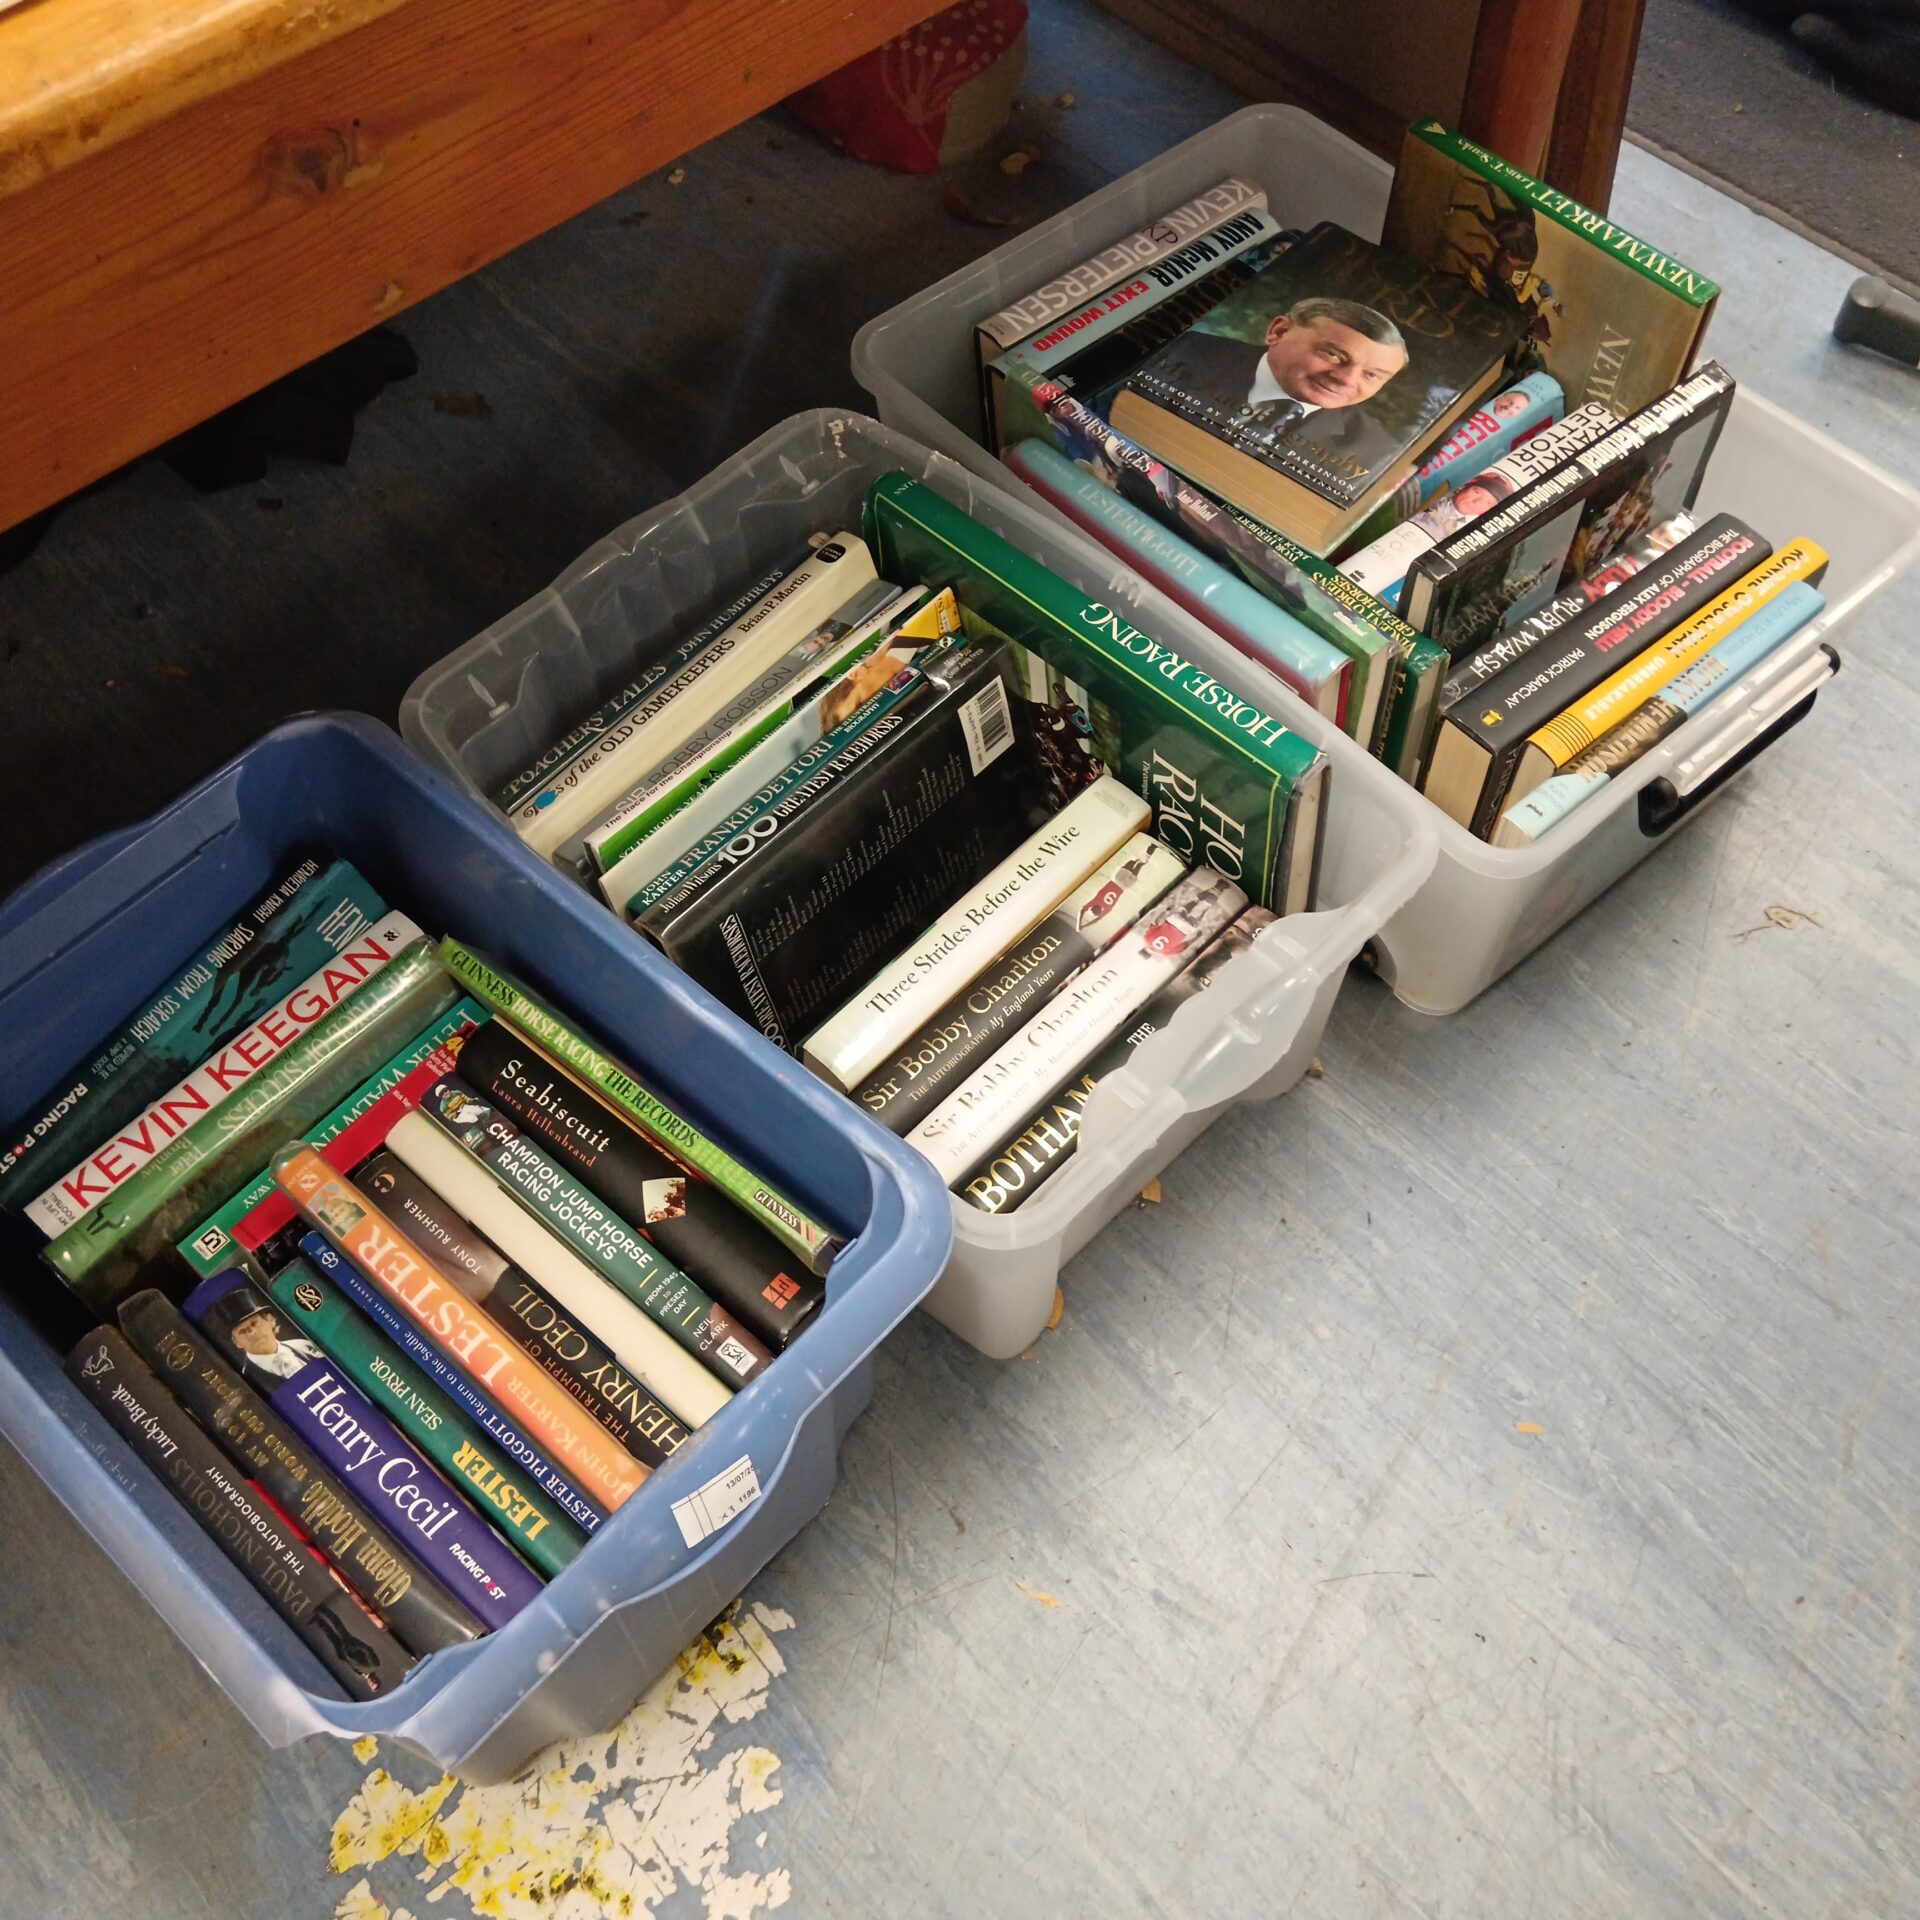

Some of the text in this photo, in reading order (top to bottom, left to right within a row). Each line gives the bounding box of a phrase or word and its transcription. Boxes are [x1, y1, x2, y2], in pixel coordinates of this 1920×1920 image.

[1165, 178, 1255, 237] KEVIN
[1222, 213, 1264, 251] ANDY
[1532, 188, 1706, 296] NEWMARKET
[998, 231, 1168, 332] PIETERSEN
[1102, 280, 1150, 312] EXIT
[1149, 239, 1220, 287] McNAB
[1032, 304, 1105, 352] WOUND
[1021, 371, 1070, 409] CLASSIC
[1070, 407, 1109, 442] HORSE
[1114, 438, 1155, 473] RACES
[1136, 370, 1356, 492] FOREWORD BY PARKINSON
[1506, 403, 1625, 478] FRANKIE DETTORI
[1446, 373, 1724, 560] Long The National John Hughes and Peter Watson
[1078, 484, 1136, 533] LESTER
[1331, 575, 1378, 608] HORSES
[1377, 605, 1415, 637] GREAT
[1534, 597, 1584, 636] RUBY
[1584, 528, 1740, 640] THE BIOGRAPHY OF ALEX FERGUSON
[1630, 536, 1755, 629] FOOTBALL BLOODY
[564, 572, 811, 788] of the OLD GAMEKEEPERS Brian Martin
[605, 568, 784, 713] TALES JOHN HUMPHREYS
[1079, 602, 1194, 682] RACING
[1469, 629, 1540, 679] WALSH
[1505, 647, 1586, 709] PATRICK BARCLAY
[713, 667, 793, 741] ROBSON
[829, 691, 884, 738] THE ILLUSTRATED
[844, 702, 881, 733] BIOGRAPHY
[1182, 671, 1292, 749] HORSE
[1583, 656, 1668, 721] UNBREAKABLE
[605, 730, 733, 829] The for the Championship
[659, 886, 691, 914] Julian
[717, 815, 778, 865] 100
[773, 764, 835, 818] GREATEST
[834, 713, 904, 773] RACEHORSES
[680, 739, 834, 868] FRANKIE DETTORI
[642, 869, 672, 897] JOHN
[642, 869, 687, 907] KARTER
[865, 825, 1081, 1015] Three Strides Before the Wire
[130, 858, 320, 1044] HENRIETTA KNIGHT STARTING FROM SCRATCH
[719, 914, 775, 1029] GREATEST RACEHORSES
[451, 949, 700, 1148] GUINNESS HORSE RACING THE RECORDS
[862, 934, 1063, 1112] Sir Bobby Charlton
[908, 968, 1056, 1102] THE AUTOBIOGRAPHY My England Years
[923, 968, 1119, 1139] Sir Bobby Charlton
[1126, 1022, 1156, 1047] THE
[33, 1082, 89, 1137] RACING
[62, 936, 392, 1210] KEVIN KEEGAN
[212, 1057, 307, 1139] SUCCESS
[500, 1059, 612, 1153] Seabiscuit
[491, 1080, 597, 1169] Laura Hillenbrand
[965, 1073, 1098, 1214] BOTHAM
[50, 1191, 77, 1222] FOOTBALL
[242, 1184, 271, 1209] WAY
[486, 1122, 653, 1269] CHAMPION JUMP HORSE
[497, 1151, 616, 1263] RACING JOCKEYS
[755, 1189, 800, 1228] GUINNESS
[403, 1198, 482, 1275] TONY RUSHMER
[645, 1271, 679, 1307] FROM 1945
[659, 1285, 689, 1317] PRESENT
[663, 1290, 673, 1299] to
[673, 1299, 688, 1315] DAY
[692, 1317, 716, 1339] NEIL
[357, 1223, 636, 1501] JOHN KARTER LESTER
[509, 1284, 689, 1457] HENRY CECIL
[699, 1320, 730, 1352] CLARK
[111, 1383, 179, 1459] Lucky Break
[373, 1303, 601, 1531] LESTER PIGGOTT Return to the Saddle MICHAEL
[523, 1339, 630, 1443] THE TRIUMPH OF
[239, 1407, 309, 1481] WORLD CUP
[245, 1446, 270, 1468] MY
[296, 1371, 459, 1541] Henry Cecil
[369, 1355, 550, 1542] LESTER SEAN PRYOR
[169, 1457, 313, 1617] PAUL NICHOLLS
[205, 1465, 305, 1576] THE AUTOBIOGRAPHY
[301, 1480, 412, 1608] Glenn Hoddle
[449, 1542, 507, 1601] RACING POST
